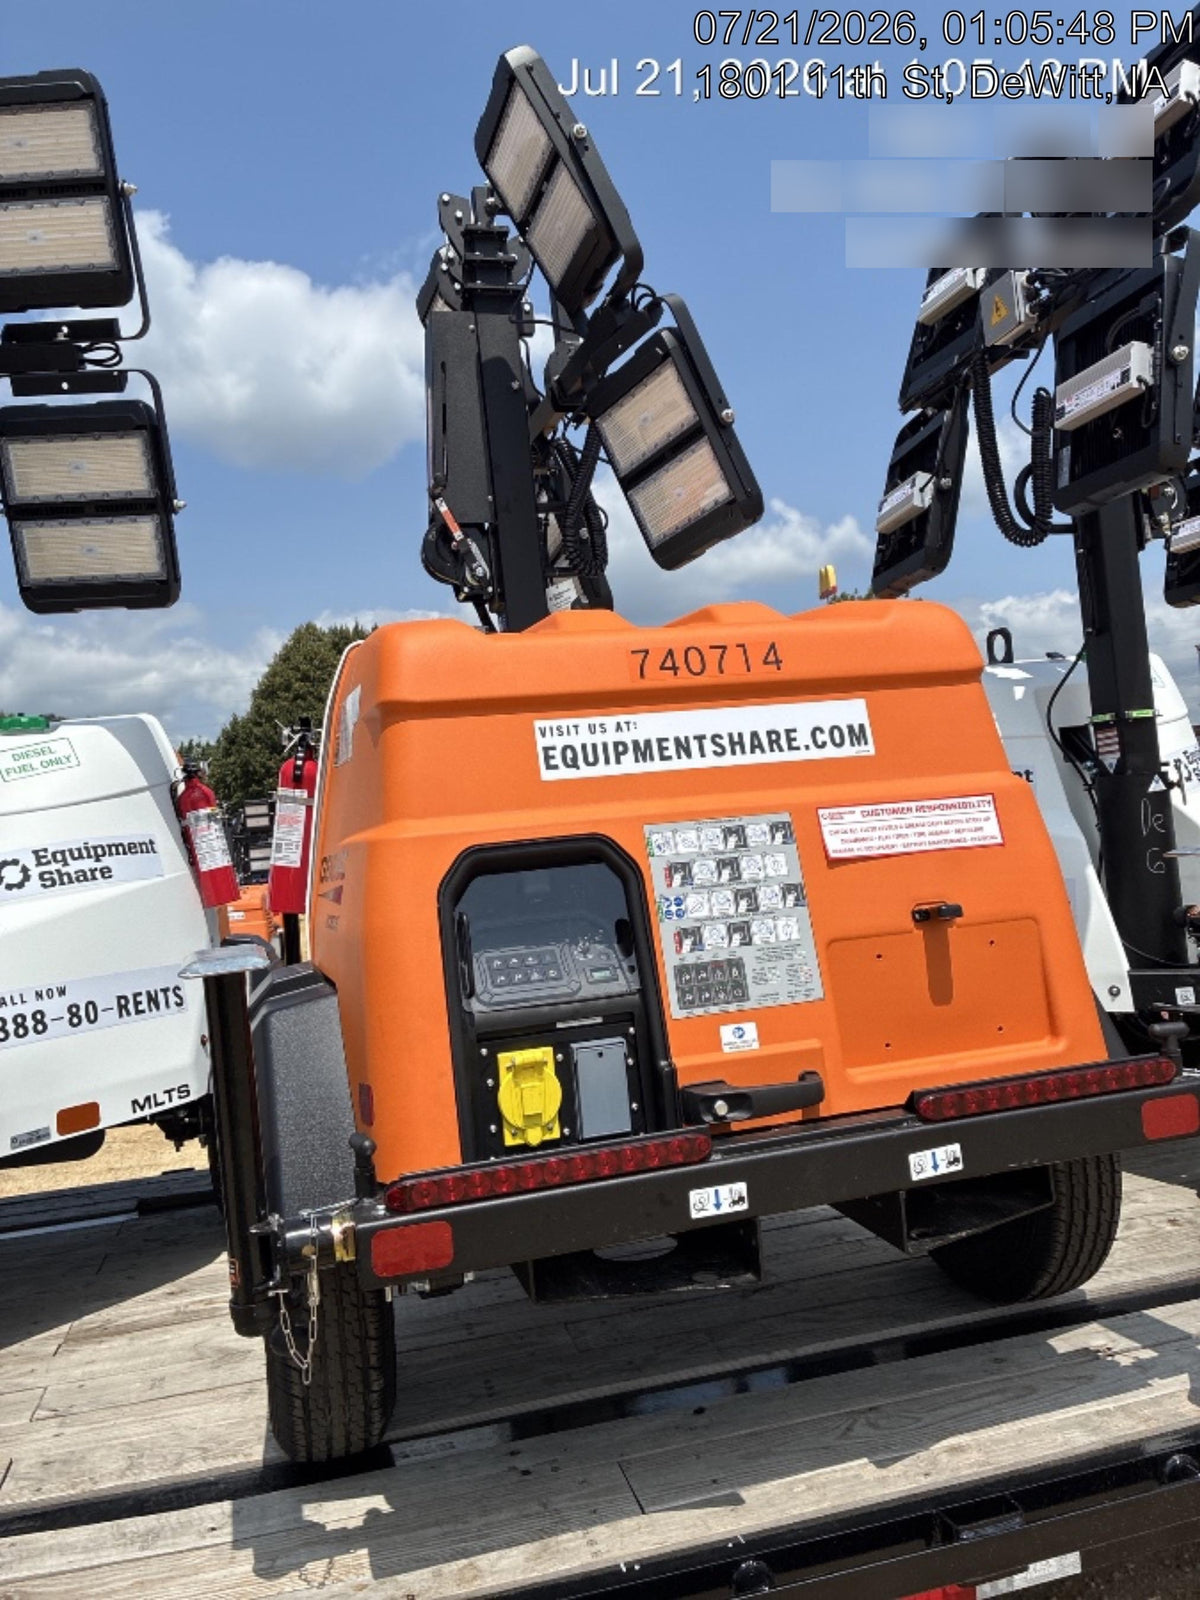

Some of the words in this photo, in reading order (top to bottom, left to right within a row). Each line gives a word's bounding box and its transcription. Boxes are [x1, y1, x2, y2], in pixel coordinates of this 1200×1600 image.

[631, 641, 783, 679] 740714
[538, 724, 580, 738] VISIT
[588, 722, 607, 735] US
[615, 721, 638, 733] AT:
[11, 745, 57, 762] DIESEL
[542, 723, 869, 771] EQUIPMENTSHARE.COM
[5, 763, 38, 777] FUEL
[40, 754, 73, 769] ONLY
[32, 838, 157, 868] Equipment
[38, 865, 113, 889] Share
[35, 984, 67, 1002] NOW
[131, 1084, 191, 1114] MLTS
